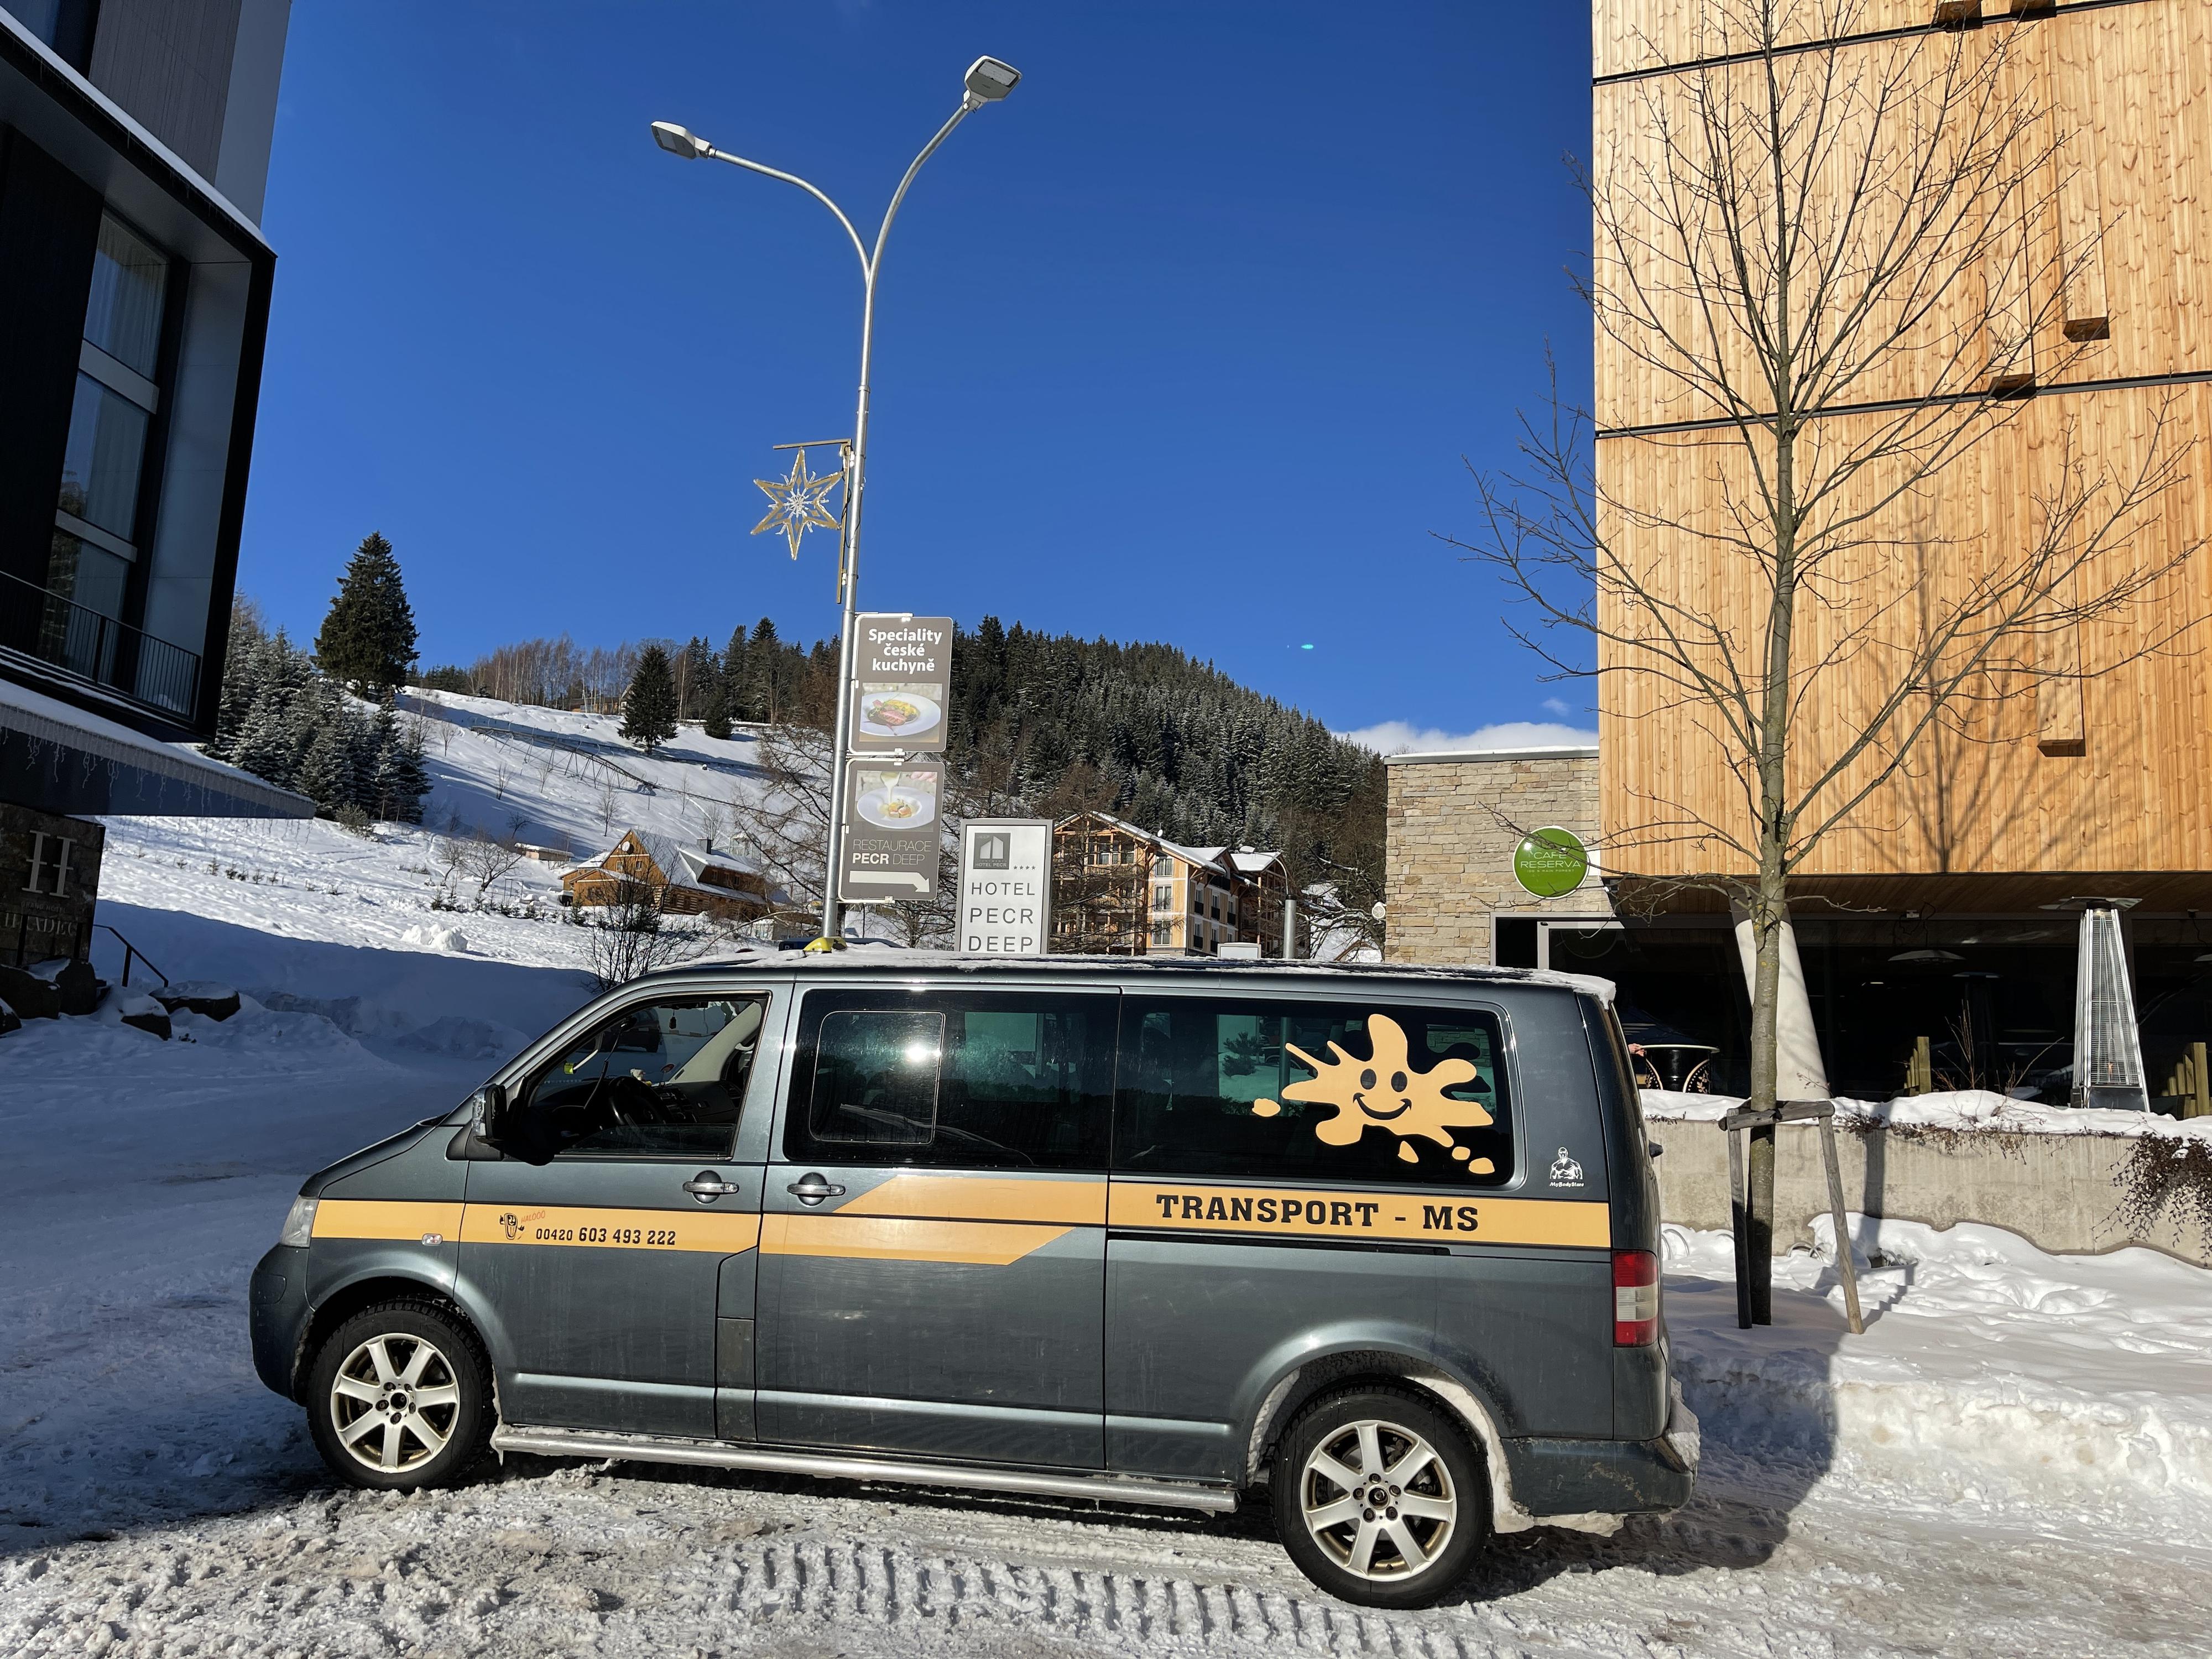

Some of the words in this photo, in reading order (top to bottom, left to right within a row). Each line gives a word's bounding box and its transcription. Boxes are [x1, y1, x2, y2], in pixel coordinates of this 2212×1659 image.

[868, 628, 942, 645] Speciality
[883, 643, 925, 656] české
[872, 658, 935, 674] kuchyně
[853, 839, 932, 852] RESTAURACE
[852, 853, 889, 864] PECR
[893, 853, 925, 865] DEEP
[971, 882, 1035, 895] HOTEL
[970, 907, 1034, 924] PECR
[968, 936, 1033, 952] DEEP
[1156, 1194, 1379, 1227] TRANSPORT
[1422, 1205, 1479, 1232] MS
[536, 1228, 573, 1241] 00420
[578, 1227, 607, 1243] 603
[613, 1229, 641, 1244] 493
[647, 1230, 676, 1245] 222
